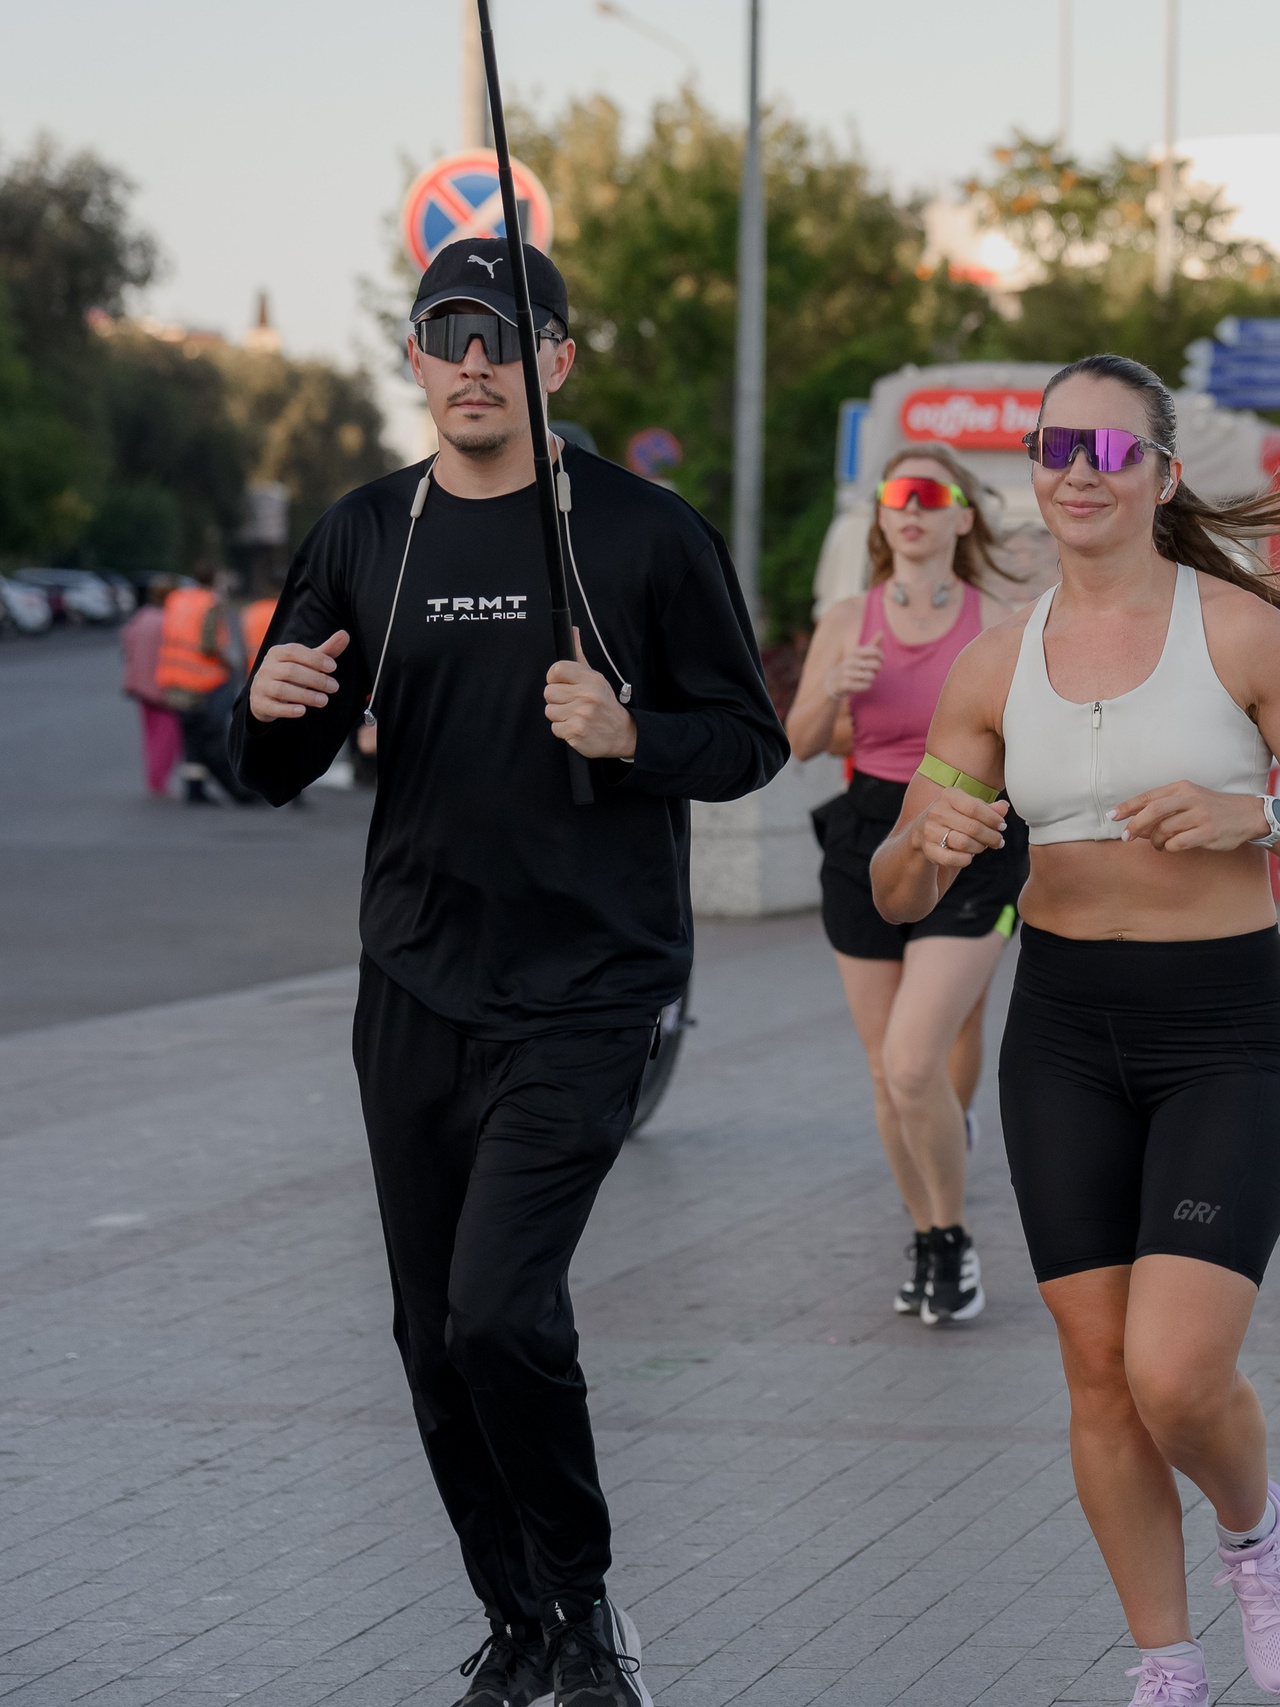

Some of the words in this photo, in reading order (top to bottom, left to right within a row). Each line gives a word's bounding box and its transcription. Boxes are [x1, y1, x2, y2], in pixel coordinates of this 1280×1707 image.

[427, 595, 527, 612] TRMT
[426, 613, 455, 623] IT'S
[459, 612, 489, 621] ALL
[492, 611, 527, 620] RIDE
